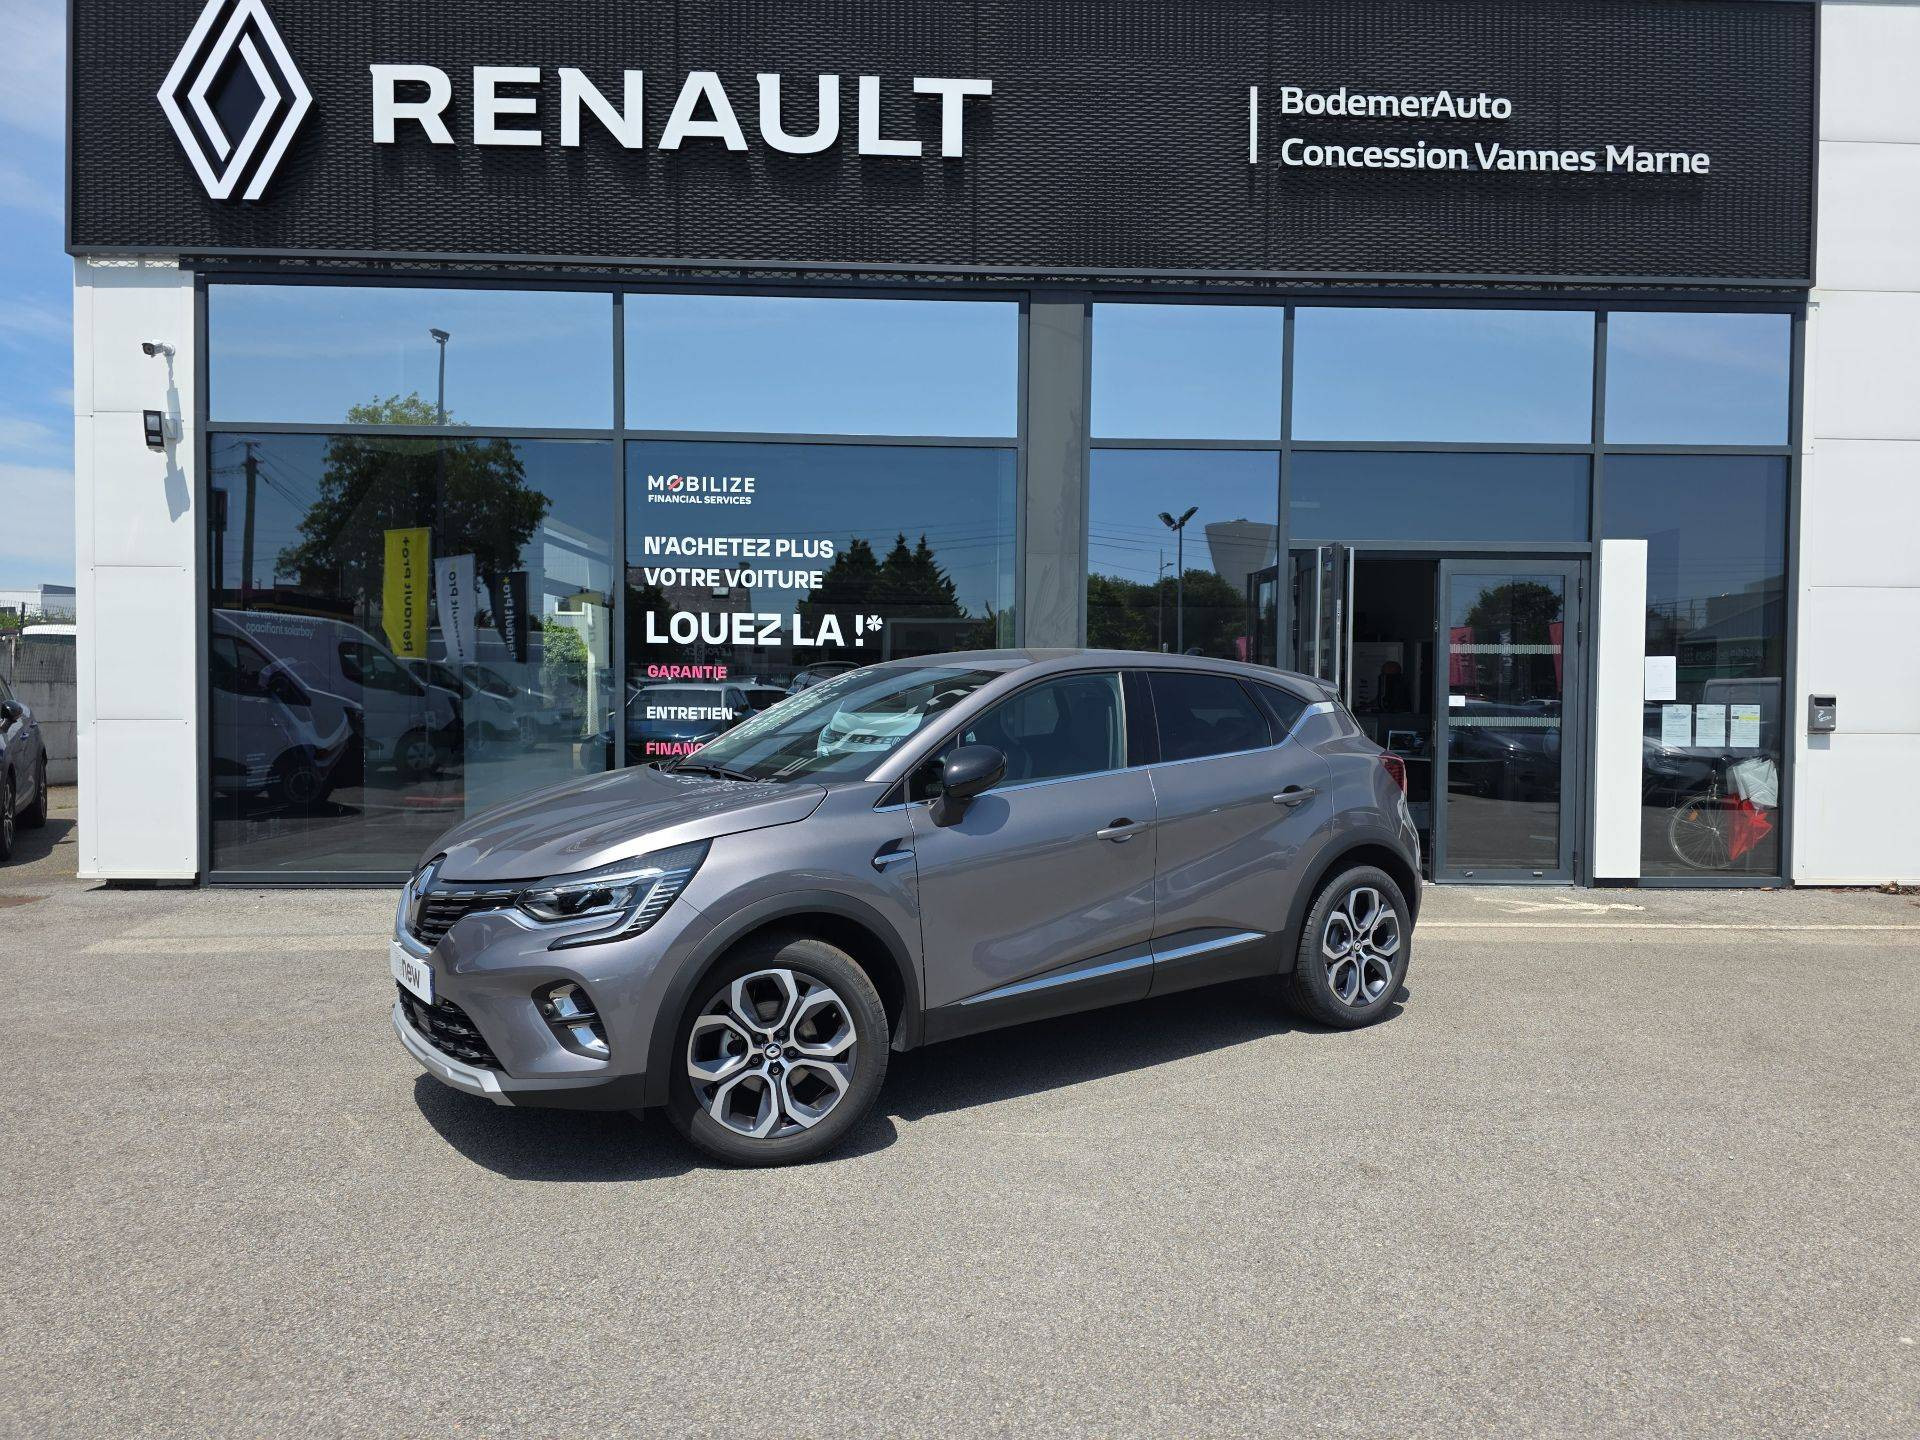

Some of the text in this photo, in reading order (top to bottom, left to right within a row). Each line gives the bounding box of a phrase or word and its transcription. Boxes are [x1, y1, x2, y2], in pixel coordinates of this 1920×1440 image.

[369, 64, 993, 158] RENAULT
[1280, 86, 1512, 119] BodemerAuto
[1281, 137, 1710, 174] Concession Vannes Marne
[647, 474, 755, 493] MOBILIZE
[647, 494, 752, 505] FINANCIAL SERVICES
[775, 539, 834, 559] PLUS
[643, 567, 823, 589] VOTRE VOITURE
[646, 611, 782, 646] LOUEZ
[792, 613, 845, 647] LA
[647, 664, 727, 680] GARANTIE
[646, 706, 733, 721] ENTRETIEN
